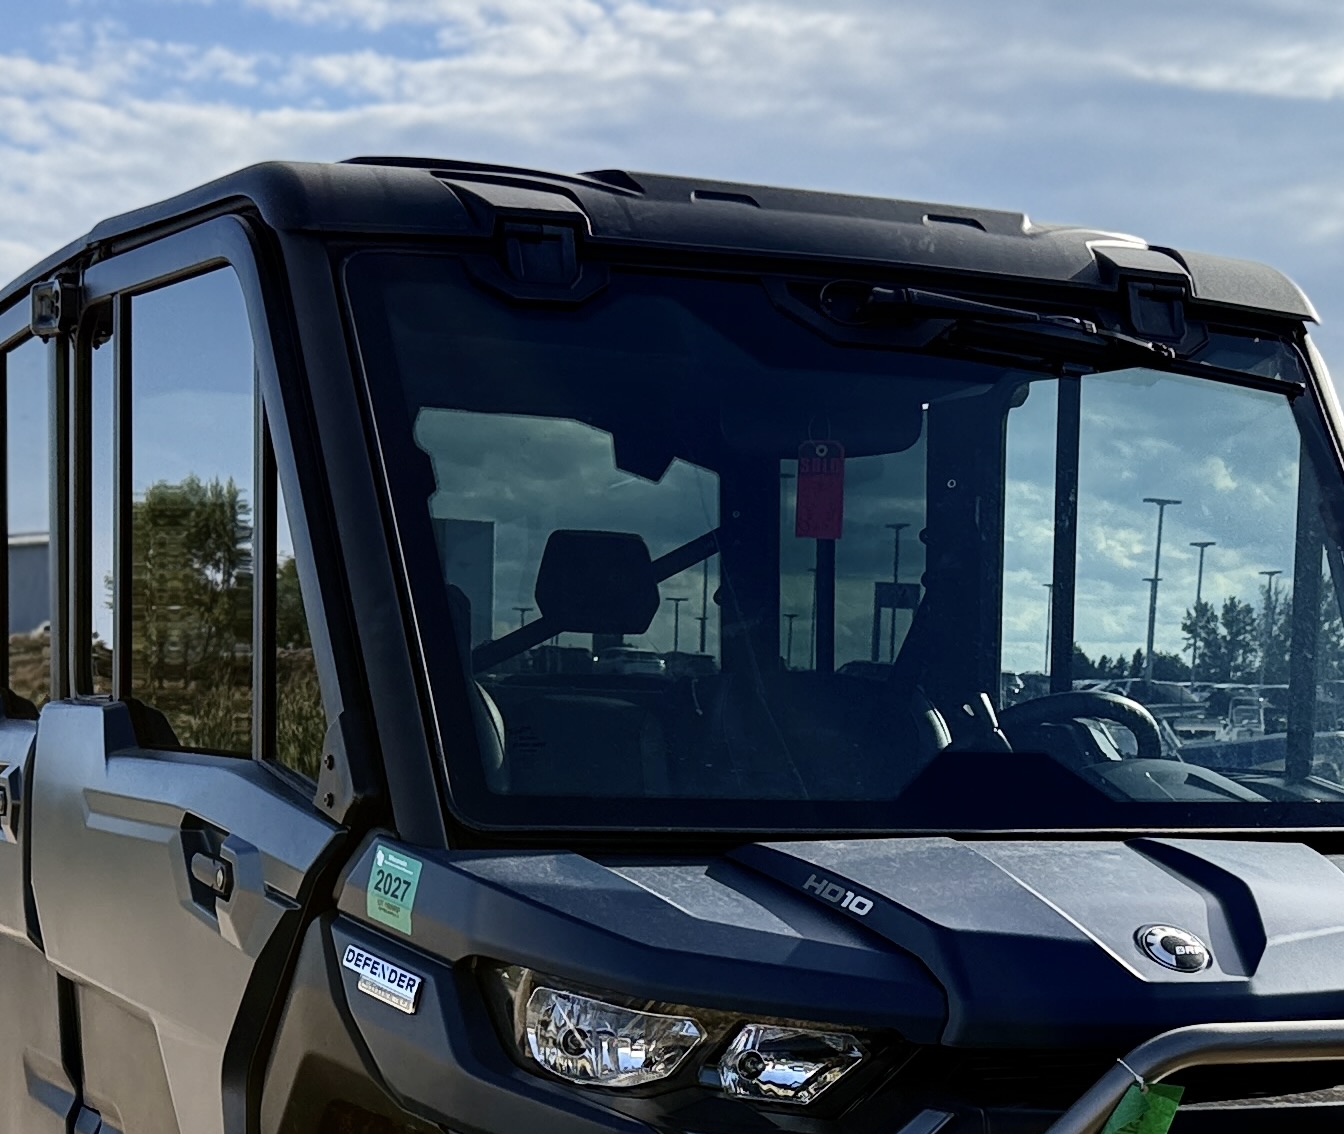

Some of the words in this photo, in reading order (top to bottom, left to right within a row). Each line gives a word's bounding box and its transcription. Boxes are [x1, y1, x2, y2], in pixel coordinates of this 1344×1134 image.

[374, 869, 411, 902] 2027
[802, 873, 874, 916] HD10
[1175, 945, 1203, 955] BRP
[345, 948, 417, 993] DEFENDER
